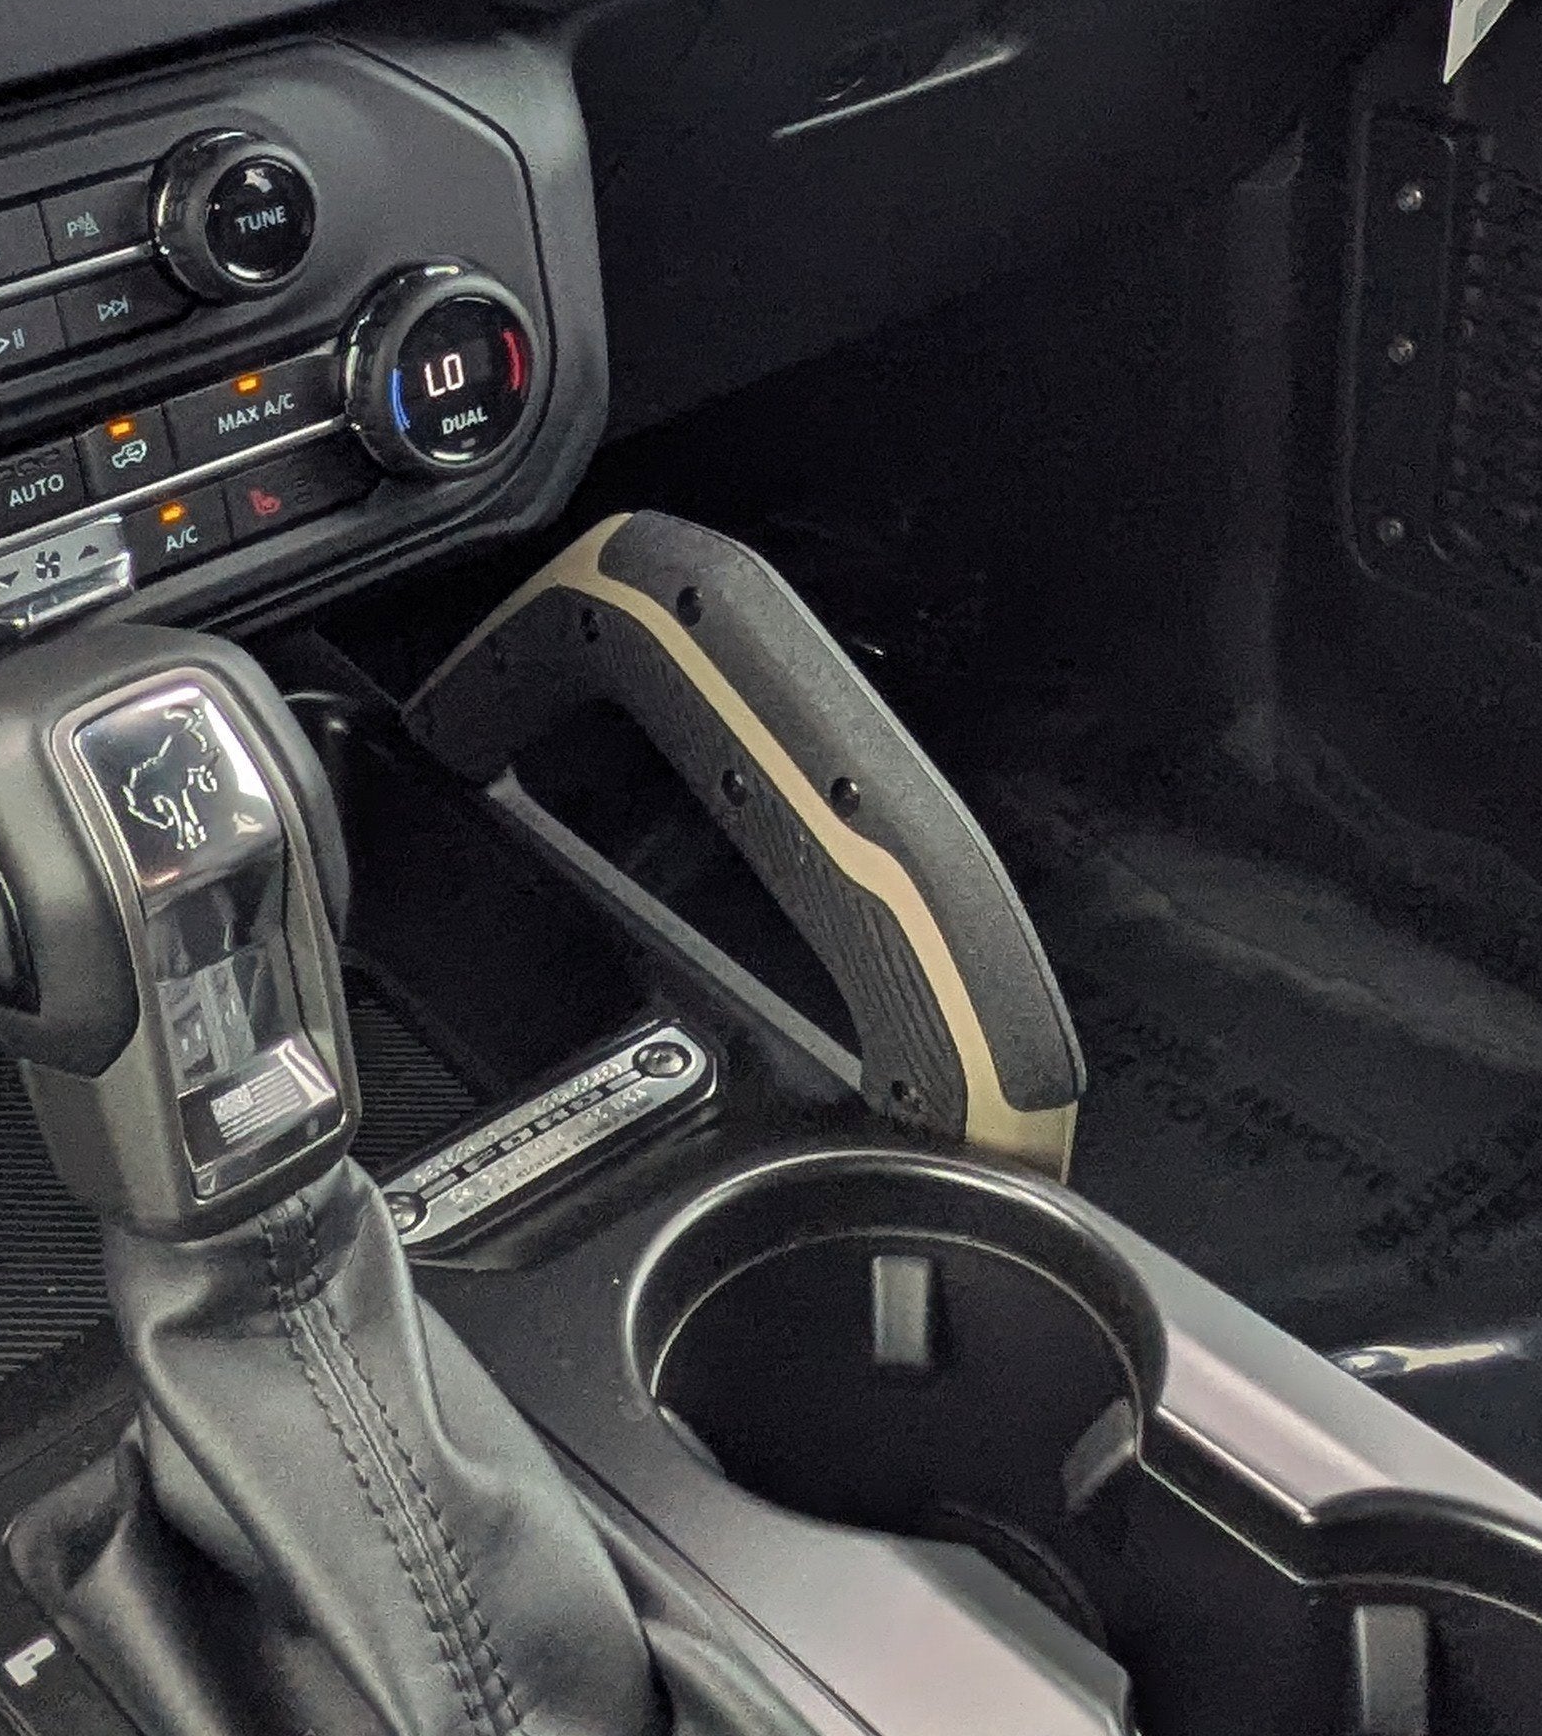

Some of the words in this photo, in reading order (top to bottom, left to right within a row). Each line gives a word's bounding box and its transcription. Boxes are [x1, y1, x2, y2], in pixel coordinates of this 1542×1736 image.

[235, 205, 287, 232] TUNE
[217, 407, 260, 435] MAX
[263, 393, 295, 419] A/C
[441, 407, 489, 436] DUAL
[9, 474, 65, 507] AUTO
[165, 525, 199, 552] A/C
[4, 1637, 56, 1687] P
